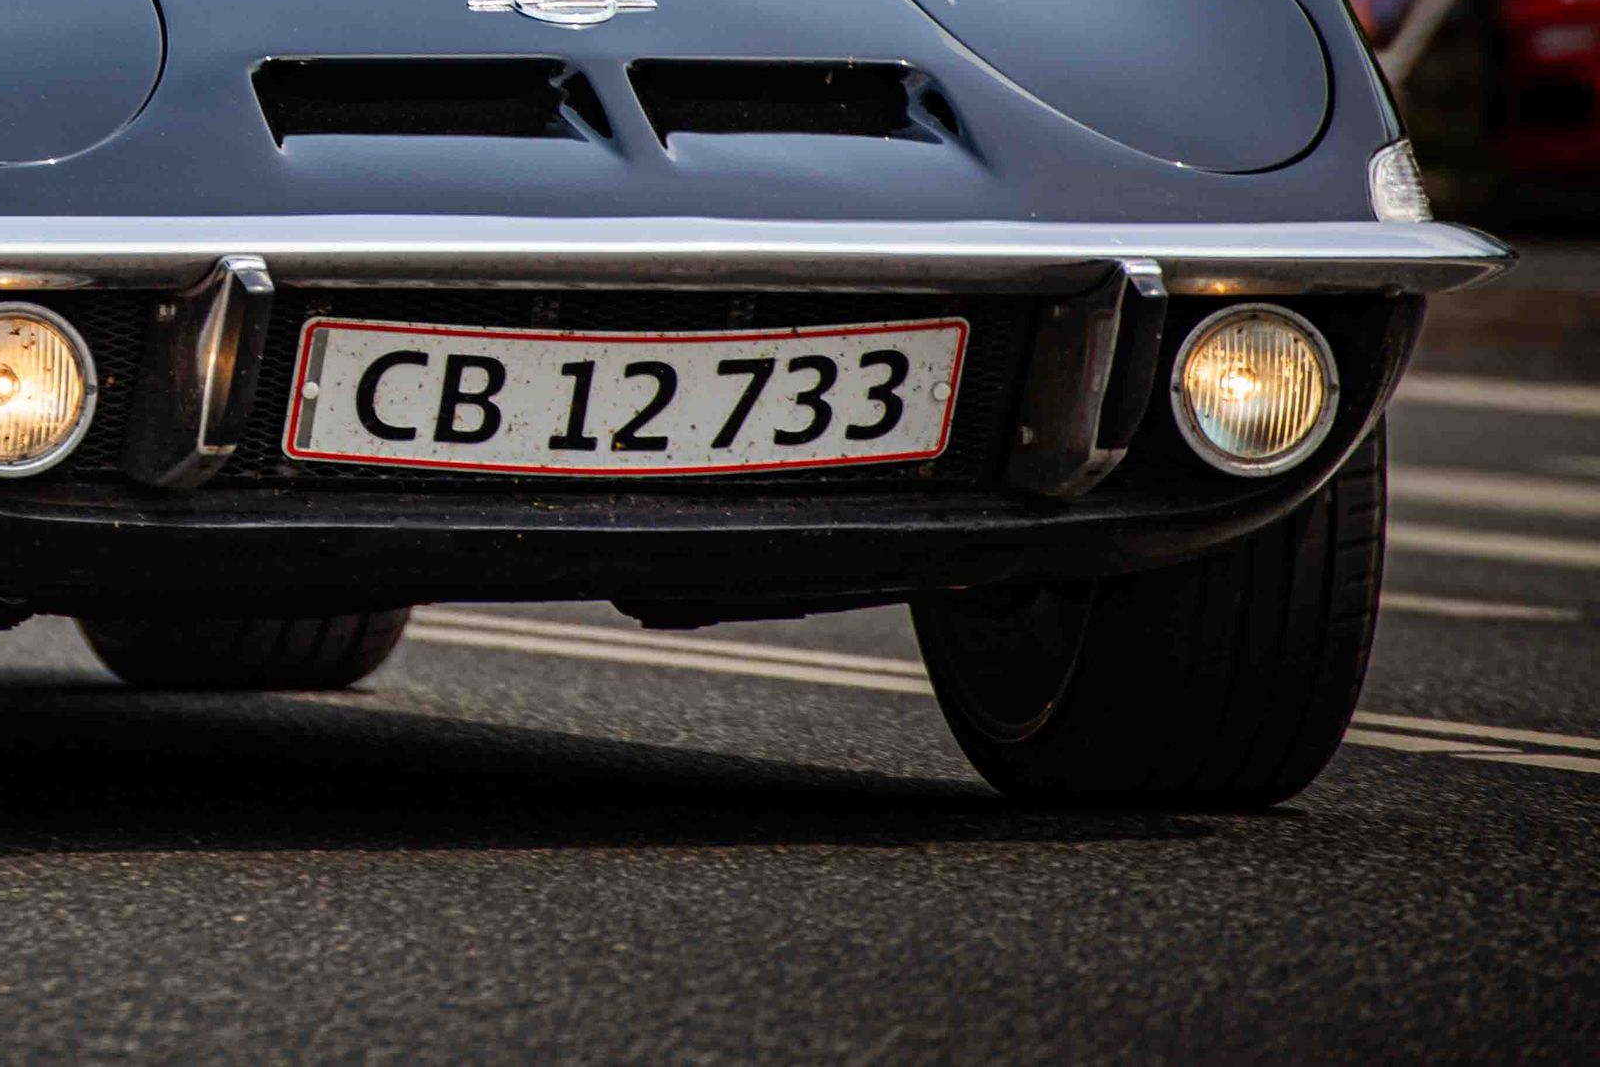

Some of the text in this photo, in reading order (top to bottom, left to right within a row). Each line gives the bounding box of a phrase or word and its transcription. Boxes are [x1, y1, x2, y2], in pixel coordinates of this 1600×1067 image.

[354, 350, 910, 452] CB 12 733
